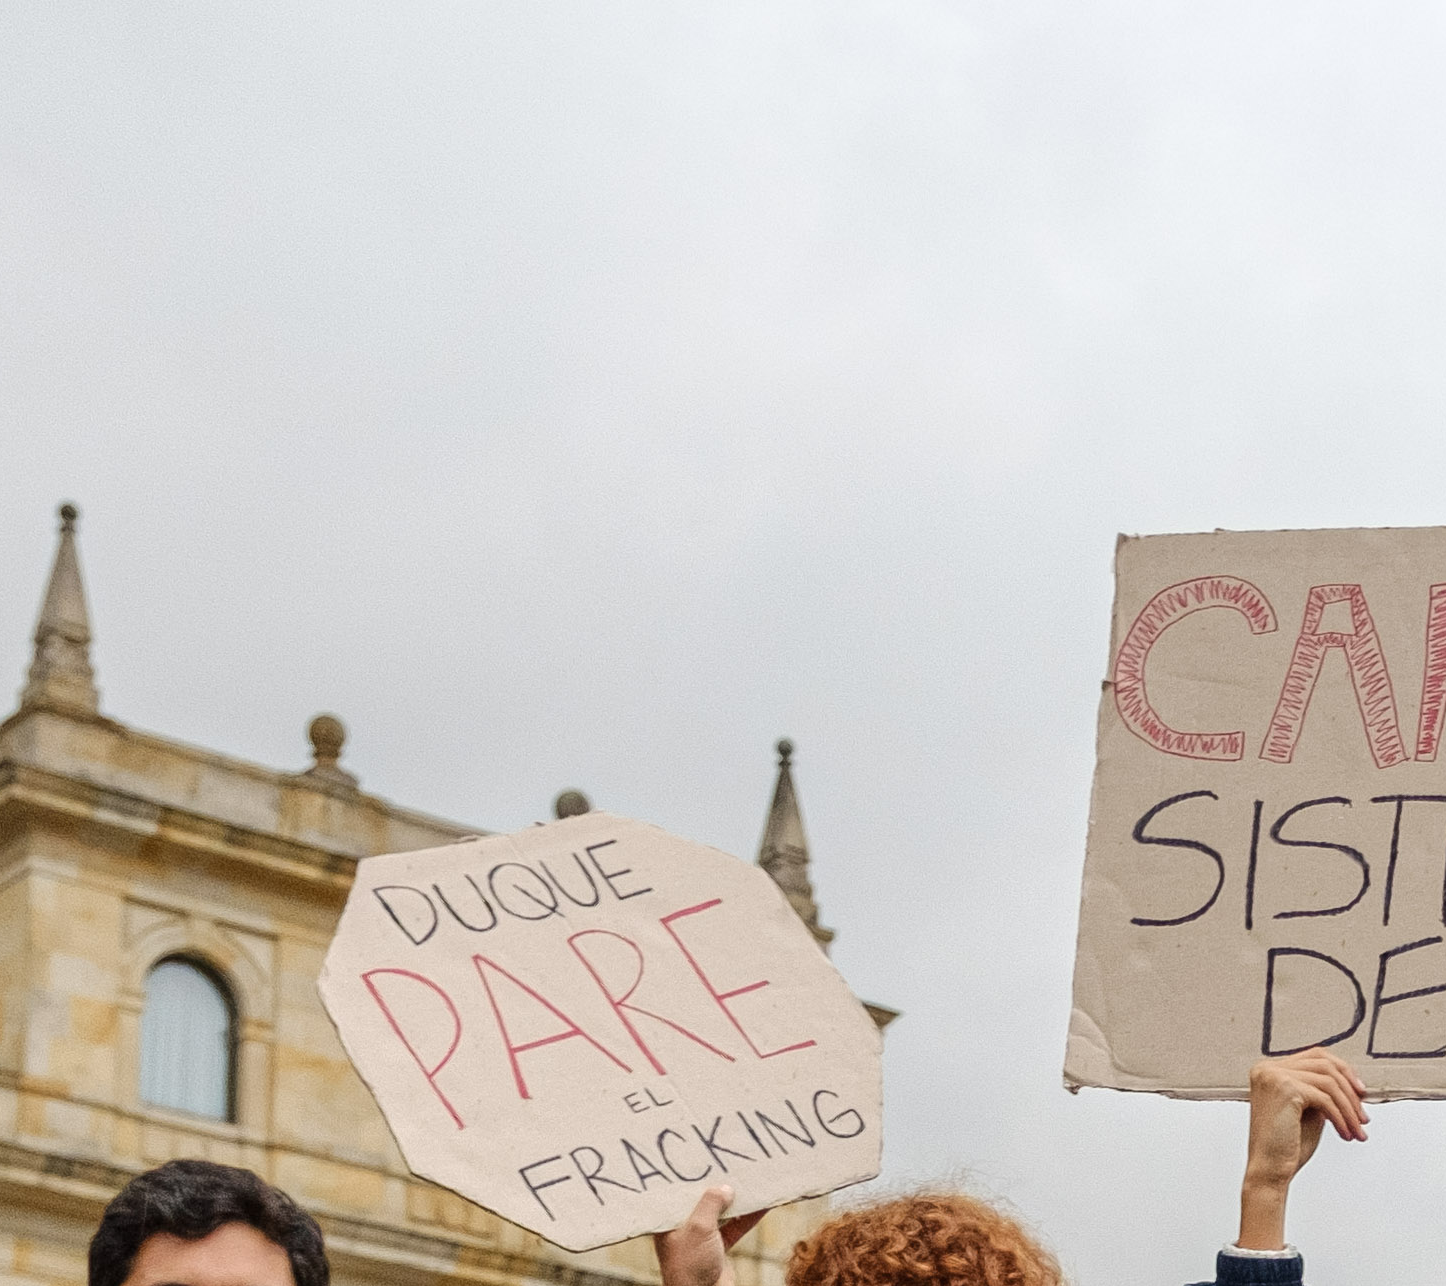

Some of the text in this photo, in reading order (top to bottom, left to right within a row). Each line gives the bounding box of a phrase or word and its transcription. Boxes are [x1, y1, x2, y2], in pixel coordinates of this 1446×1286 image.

[372, 839, 653, 946] DUQUE
[361, 898, 817, 1130] PARE
[517, 1089, 866, 1222] FRACKING
[623, 1088, 673, 1113] EL
